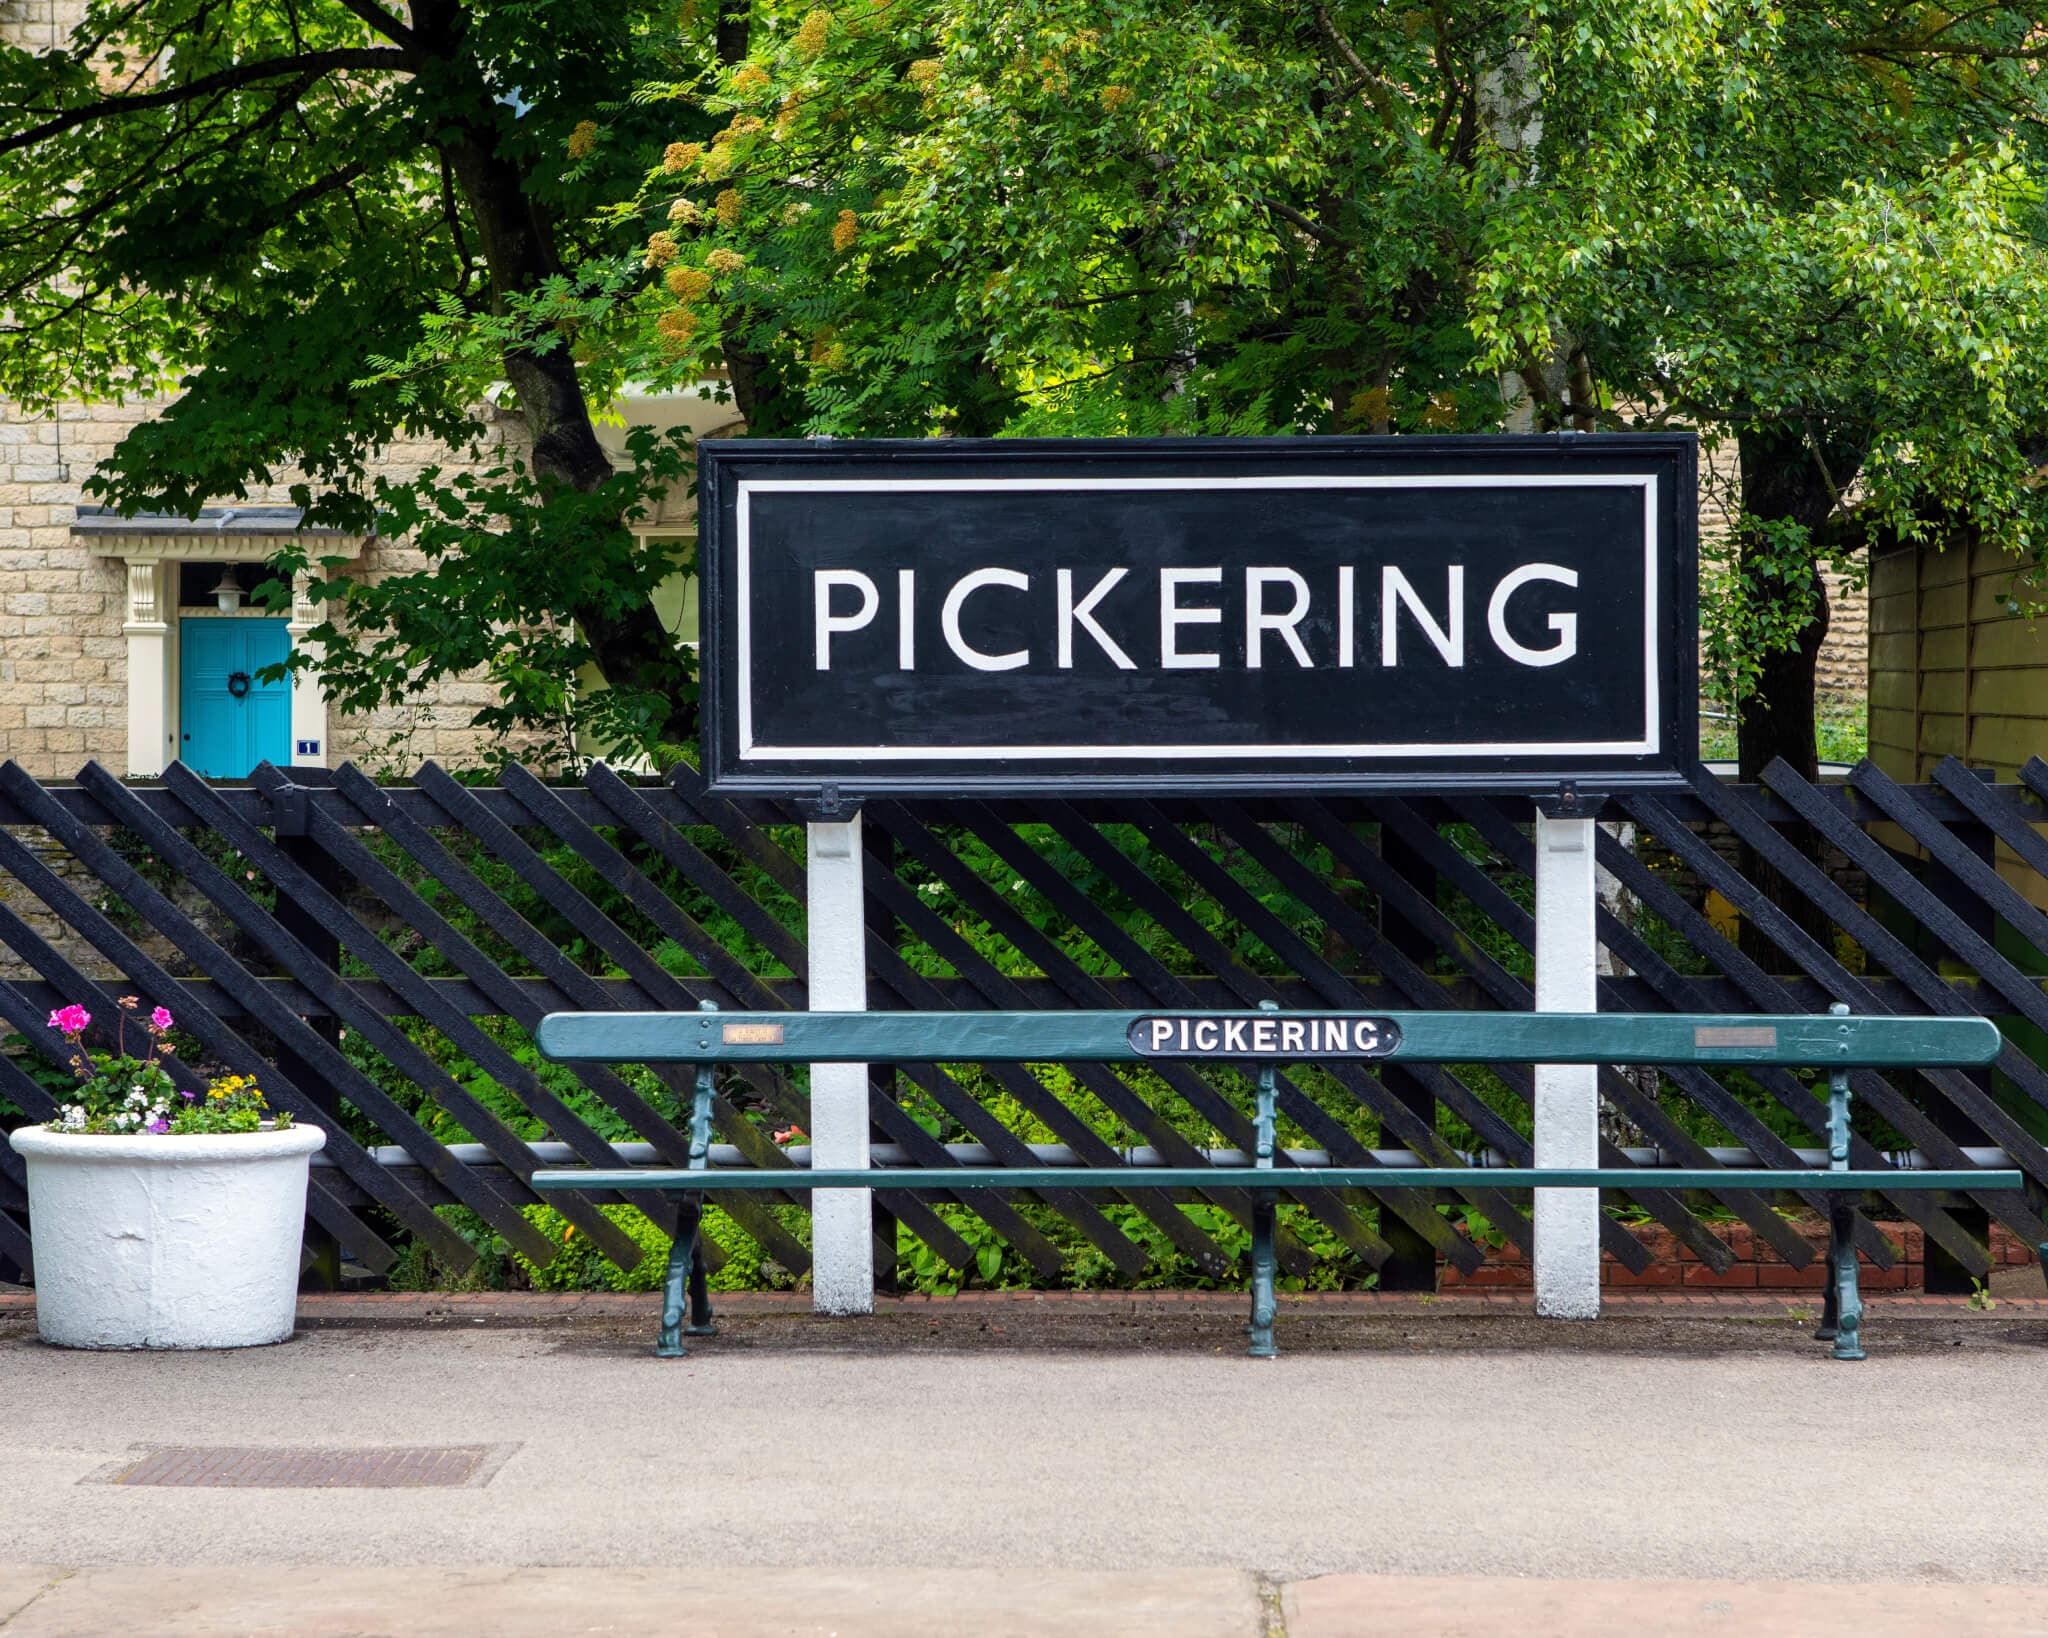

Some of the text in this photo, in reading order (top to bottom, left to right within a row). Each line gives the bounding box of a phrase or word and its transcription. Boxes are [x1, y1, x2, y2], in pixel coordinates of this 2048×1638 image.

[814, 563, 1579, 672] PICKERING
[304, 742, 312, 754] 1
[1151, 1019, 1380, 1051] PICKERING
